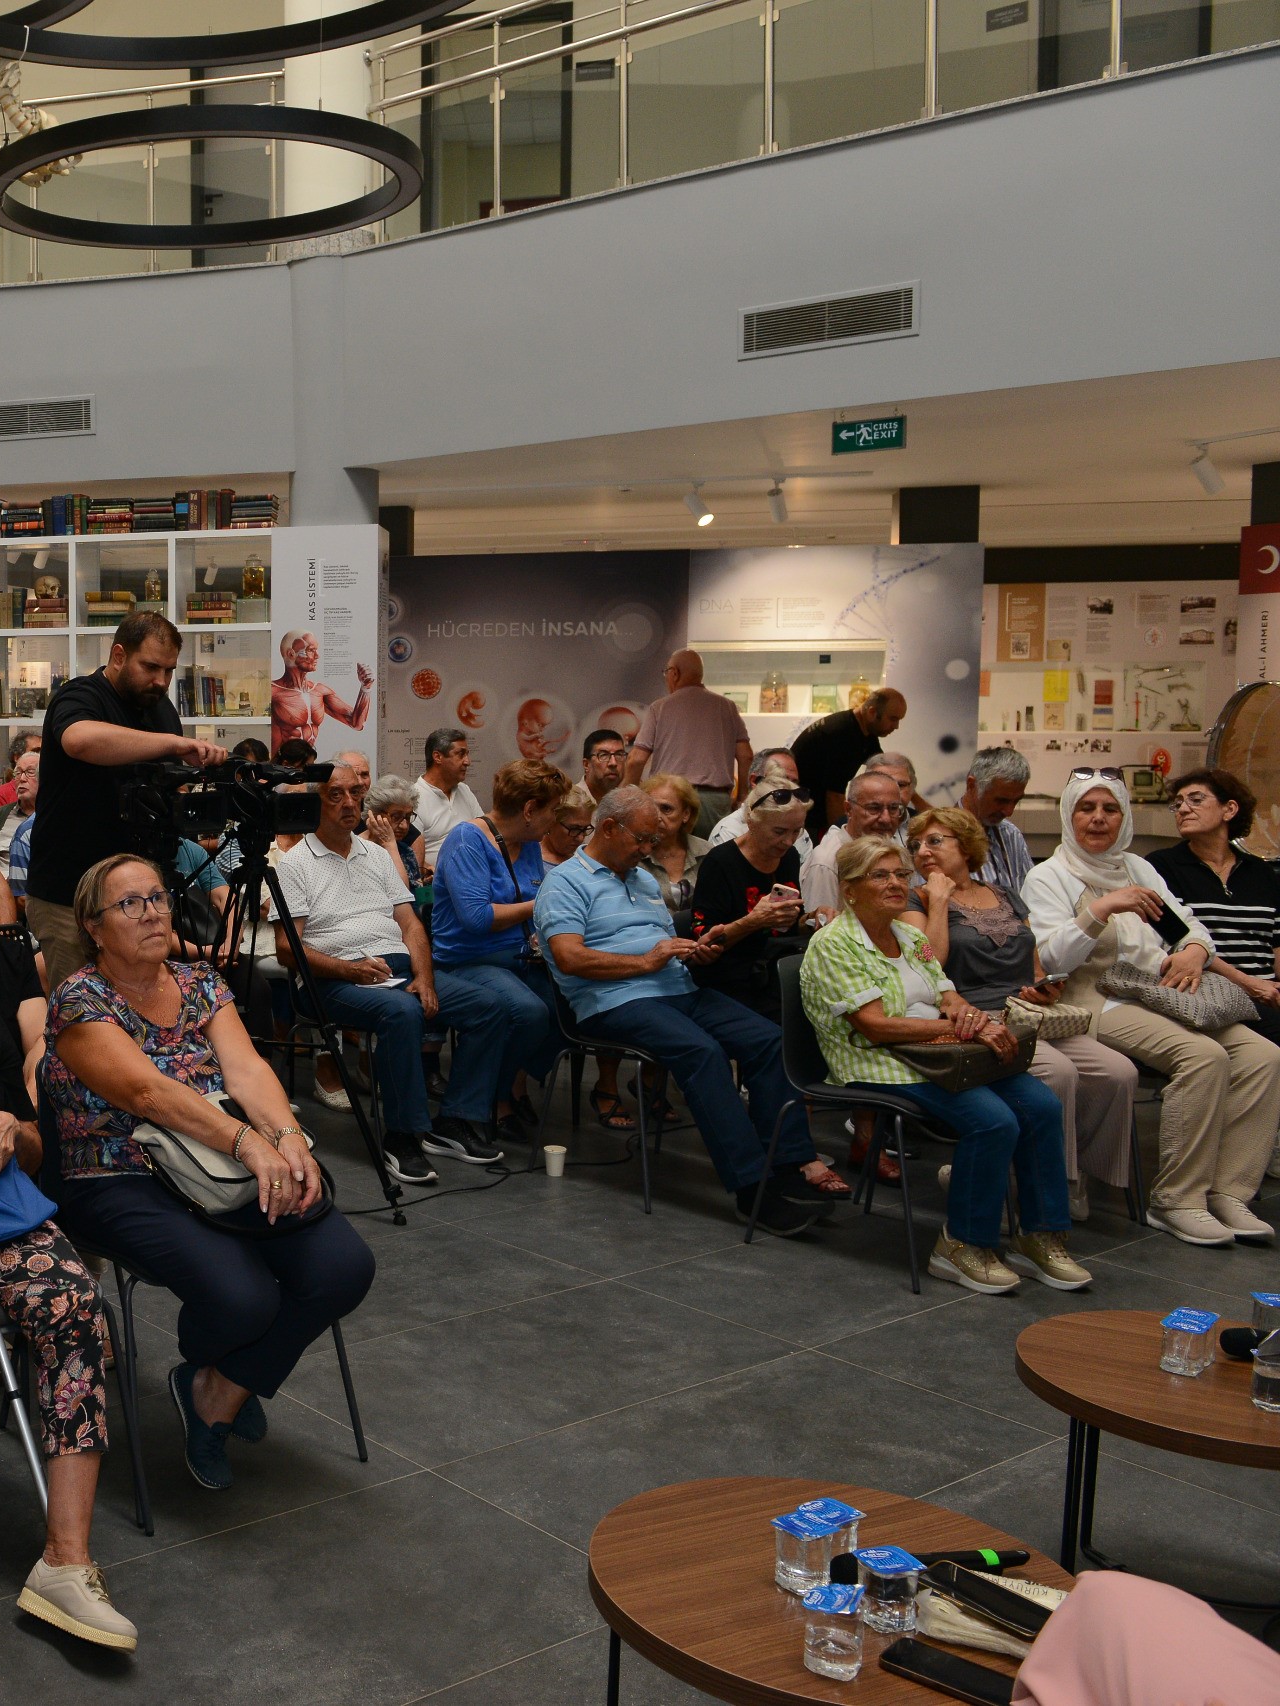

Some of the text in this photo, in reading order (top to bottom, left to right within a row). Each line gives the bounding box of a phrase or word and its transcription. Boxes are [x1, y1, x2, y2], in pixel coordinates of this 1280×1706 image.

[873, 430, 897, 439] EXIT
[307, 558, 315, 597] SİSTEMİ
[699, 599, 734, 610] DNA
[427, 620, 535, 638] HÜCREDEN
[1260, 610, 1269, 653] AHMER)
